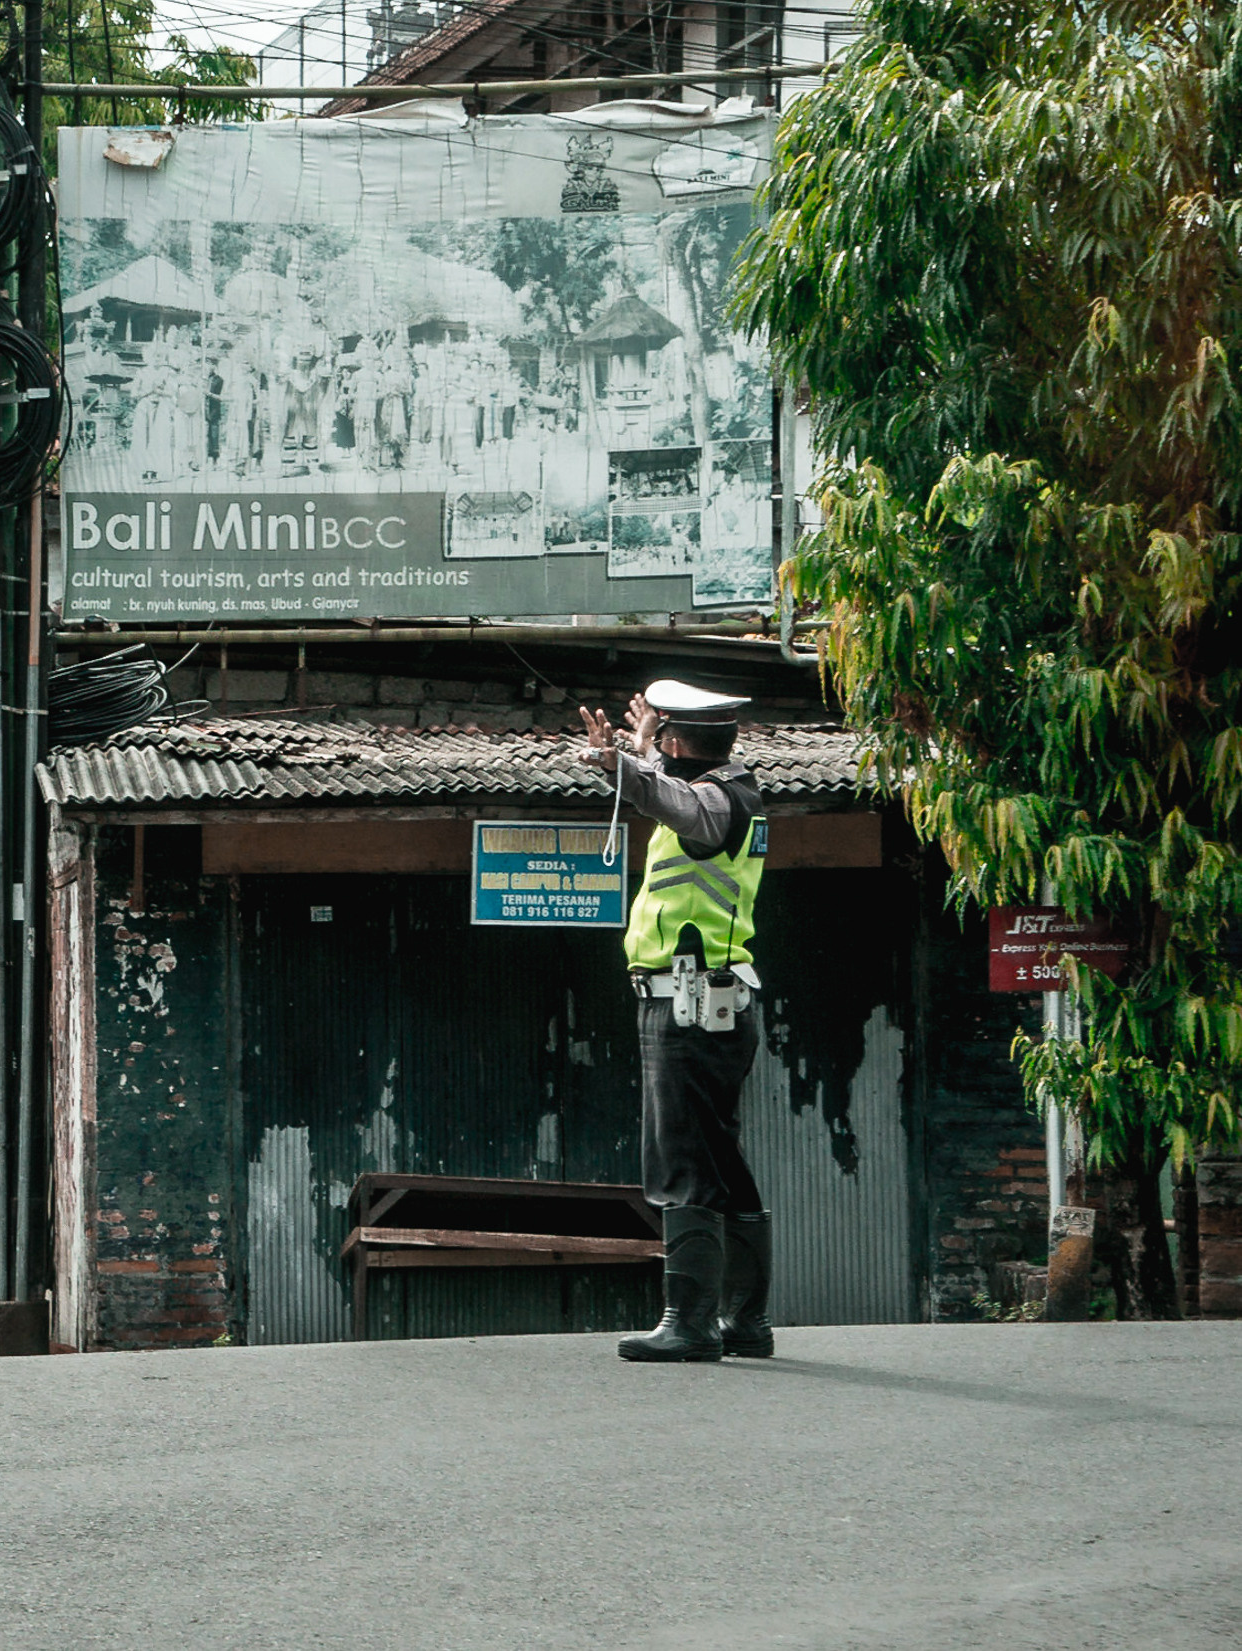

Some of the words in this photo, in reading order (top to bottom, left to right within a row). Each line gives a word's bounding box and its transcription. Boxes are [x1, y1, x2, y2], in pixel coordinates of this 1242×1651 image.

[71, 501, 171, 551] Bali
[192, 501, 316, 551] Mini
[321, 516, 407, 549] BCC
[71, 566, 152, 588] cultural
[160, 567, 251, 590] tourism,
[257, 567, 304, 588] arts
[312, 566, 350, 587] and
[358, 566, 470, 587] traditions
[71, 598, 111, 611] alamat
[147, 599, 175, 614] nyuh
[177, 599, 218, 614] kuning,
[222, 599, 238, 611] ds.
[241, 600, 268, 612] mas,
[271, 598, 301, 611] Ubud
[527, 860, 569, 871] SEDIA
[562, 876, 573, 891] &
[501, 894, 545, 906] TERIMA
[548, 895, 601, 906] PESANAN
[502, 906, 523, 917] 081
[527, 907, 549, 918] 916
[553, 907, 574, 918] 116
[1005, 914, 1056, 935] J&T
[1002, 944, 1036, 954] Express
[1060, 942, 1089, 951] Online
